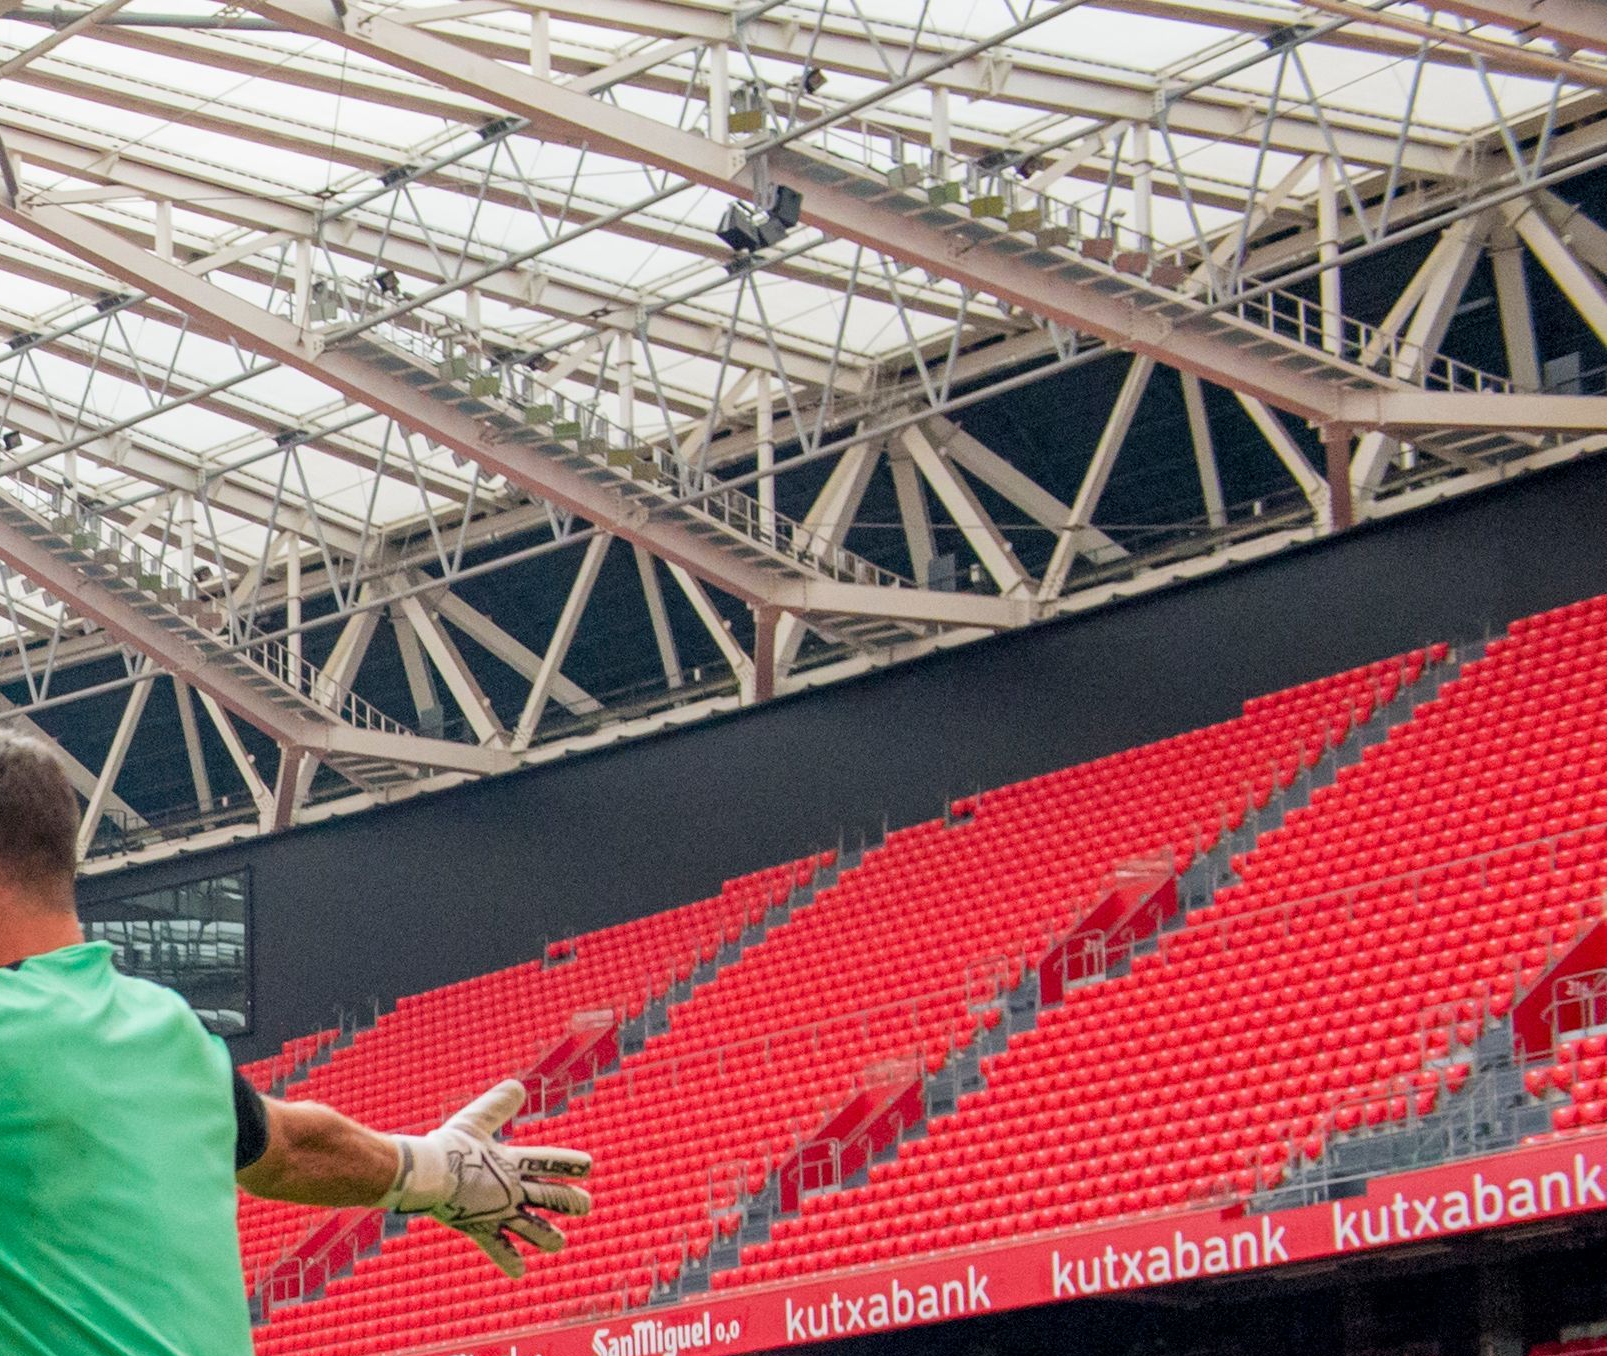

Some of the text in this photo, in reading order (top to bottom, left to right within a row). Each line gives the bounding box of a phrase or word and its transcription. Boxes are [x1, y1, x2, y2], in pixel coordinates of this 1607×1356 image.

[1333, 1153, 1606, 1251] kutxabank
[1052, 1215, 1288, 1297] kutxabank
[716, 1321, 739, 1343] 0,0
[786, 1265, 991, 1341] kutxabank
